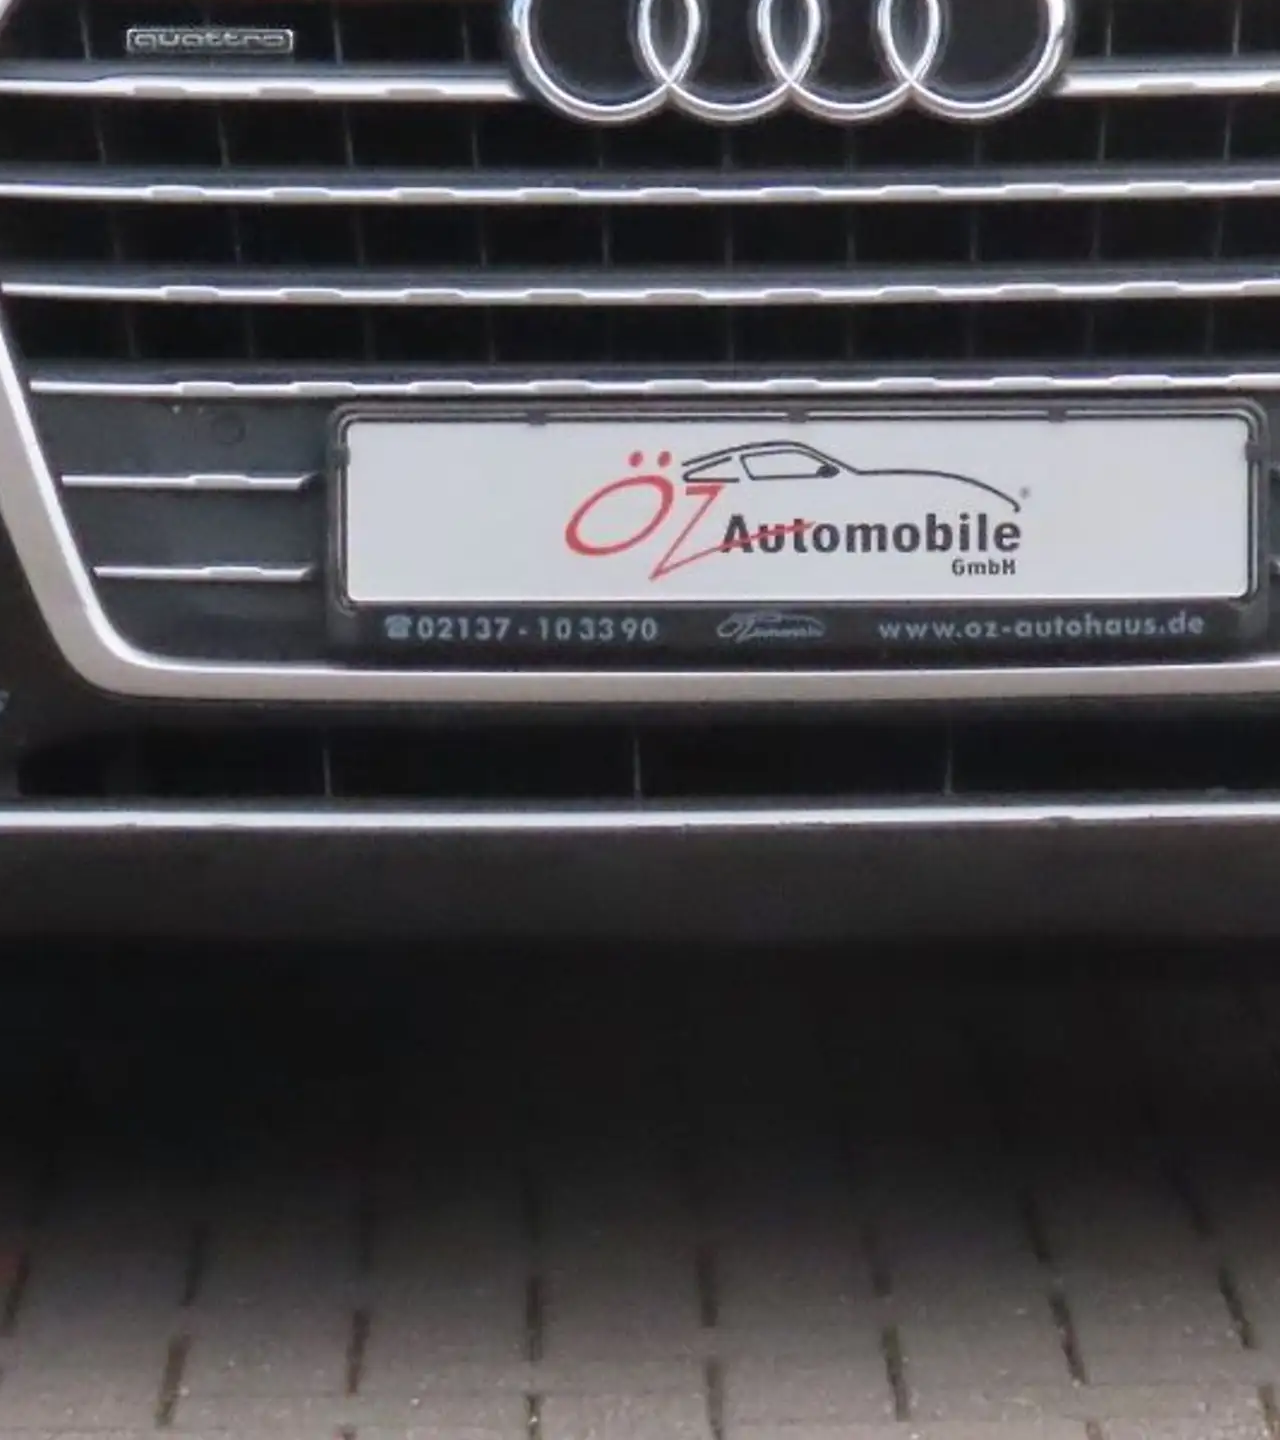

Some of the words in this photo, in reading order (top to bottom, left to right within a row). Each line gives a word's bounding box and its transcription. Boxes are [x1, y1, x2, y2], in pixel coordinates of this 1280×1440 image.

[132, 31, 287, 51] quattro
[722, 513, 1020, 553] Automobile
[951, 558, 1016, 576] GmbH
[416, 616, 511, 641] 02137
[878, 610, 1205, 640] www.oz-autohaus.de
